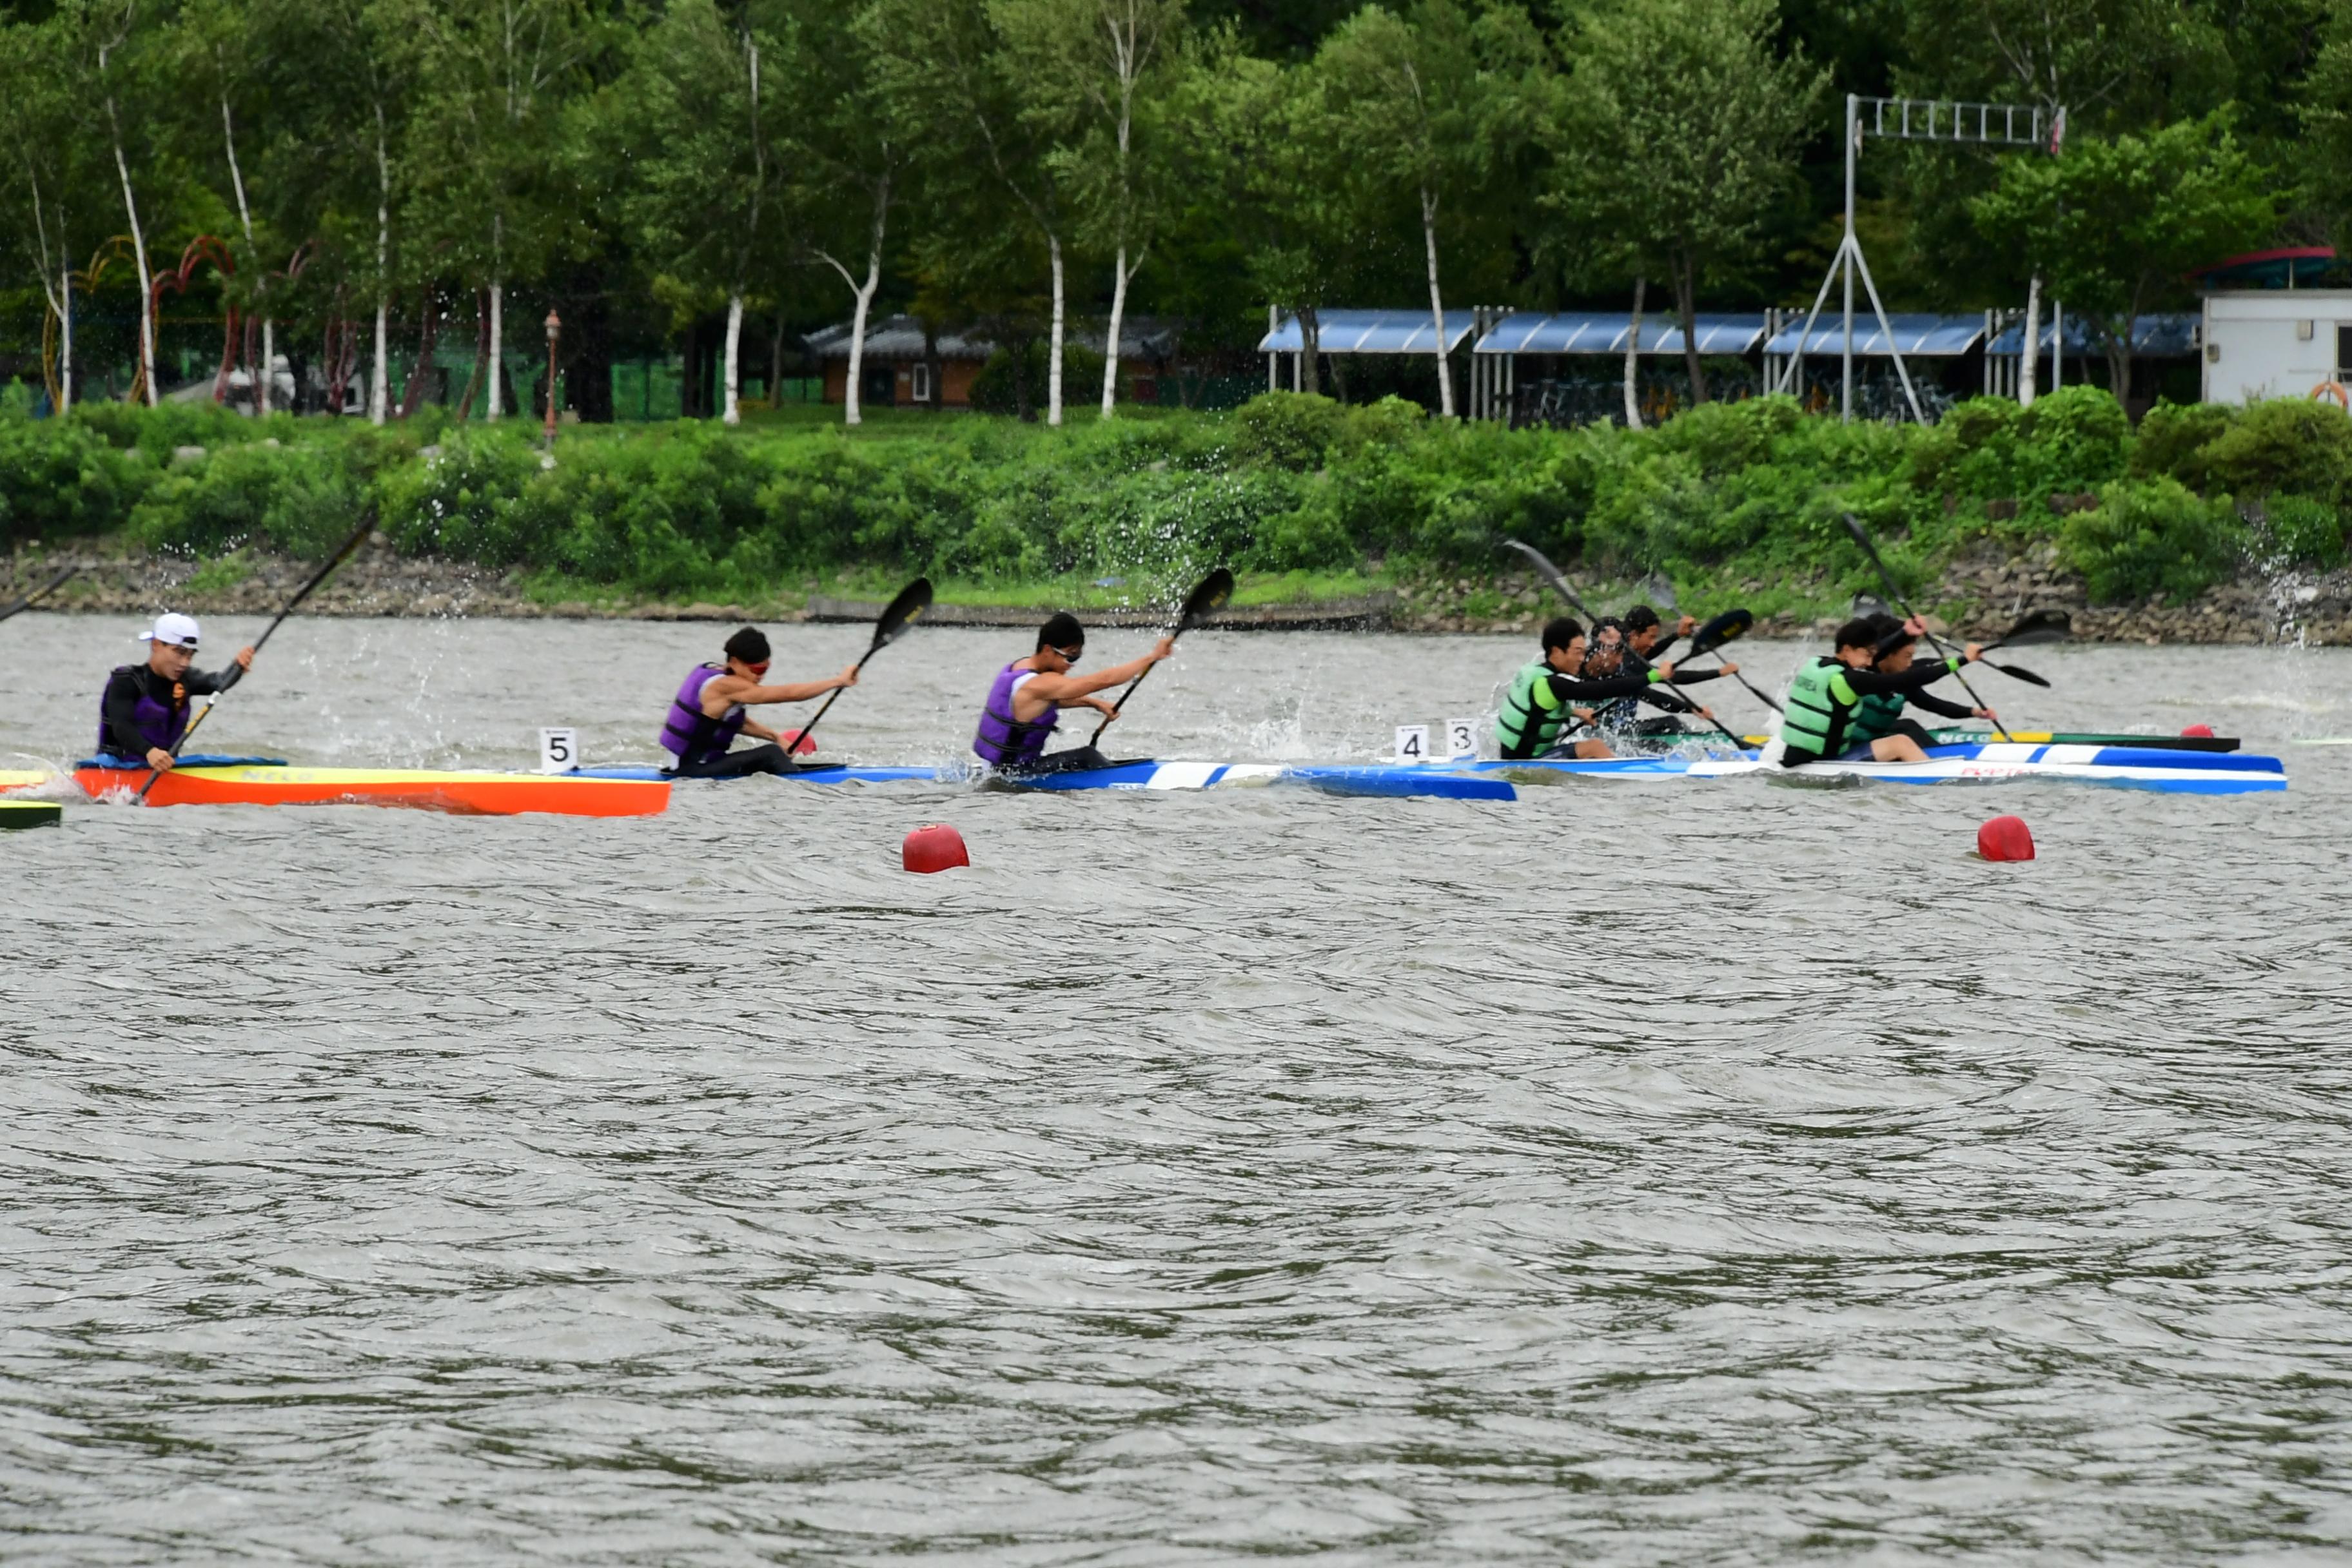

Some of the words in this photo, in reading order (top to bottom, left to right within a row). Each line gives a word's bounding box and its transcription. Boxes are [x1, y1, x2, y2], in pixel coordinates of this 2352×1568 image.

[549, 737, 569, 762] 5
[1403, 734, 1421, 758] 4
[1454, 726, 1472, 750] 3
